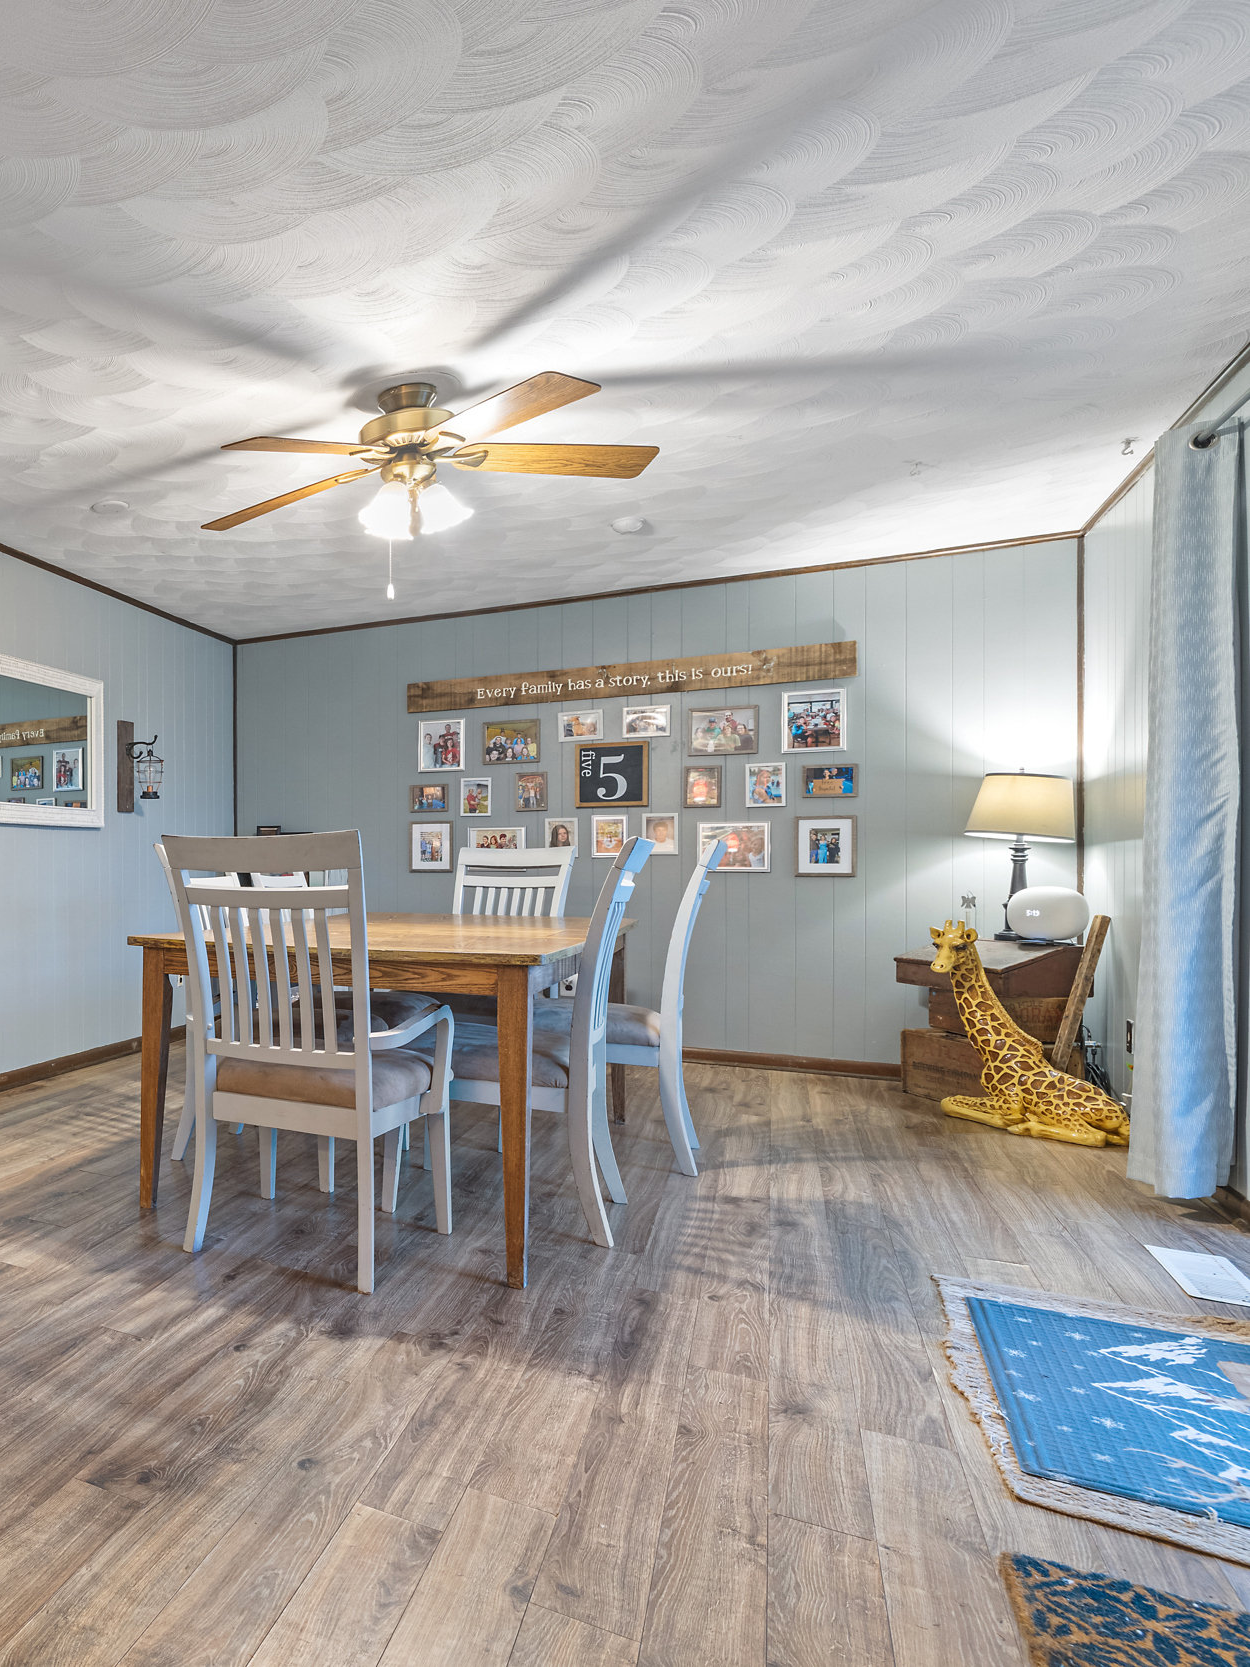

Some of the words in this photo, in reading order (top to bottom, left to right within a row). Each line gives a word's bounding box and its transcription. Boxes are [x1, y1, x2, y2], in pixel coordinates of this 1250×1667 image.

[477, 686, 517, 699] Every
[521, 681, 563, 695] family
[568, 678, 592, 691] has
[595, 678, 605, 688] a
[657, 670, 687, 683] this
[691, 667, 703, 680] is
[711, 664, 753, 678] ours!
[581, 750, 596, 777] five
[596, 753, 628, 800] 5
